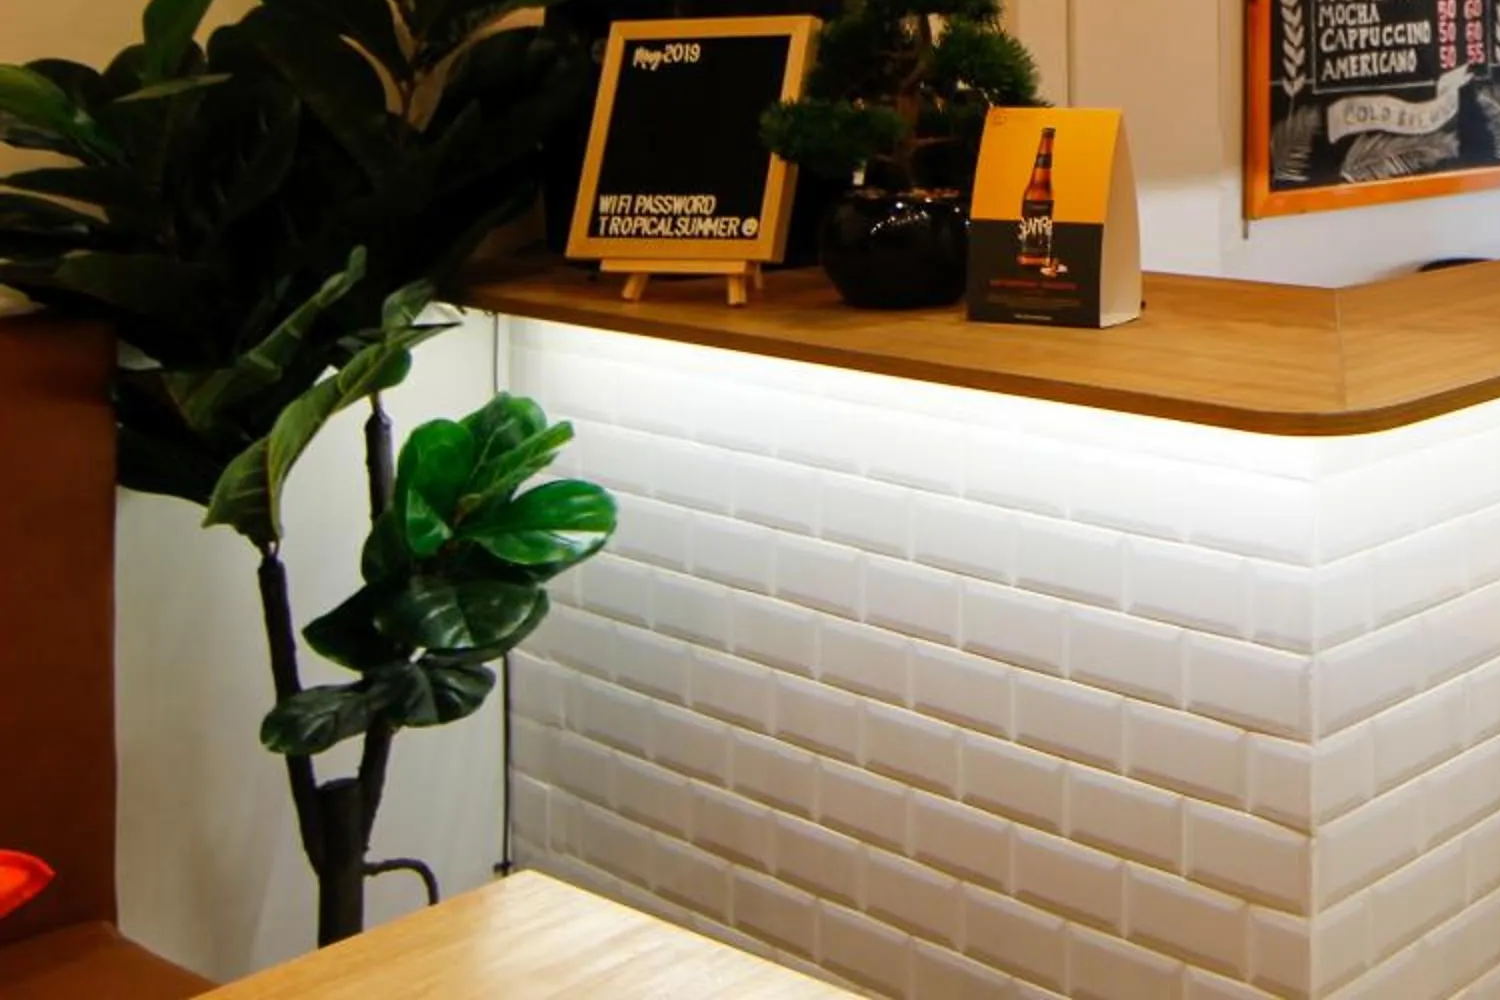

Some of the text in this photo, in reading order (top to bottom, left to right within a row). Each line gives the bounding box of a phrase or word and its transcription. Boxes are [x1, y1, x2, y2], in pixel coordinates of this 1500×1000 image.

[1318, 3, 1380, 28] MOCHA
[1320, 20, 1431, 52] CAPPUCCINO
[663, 43, 701, 63] 2019
[1321, 48, 1417, 81] AMERICANO
[599, 194, 716, 215] WIFI PASSWORD
